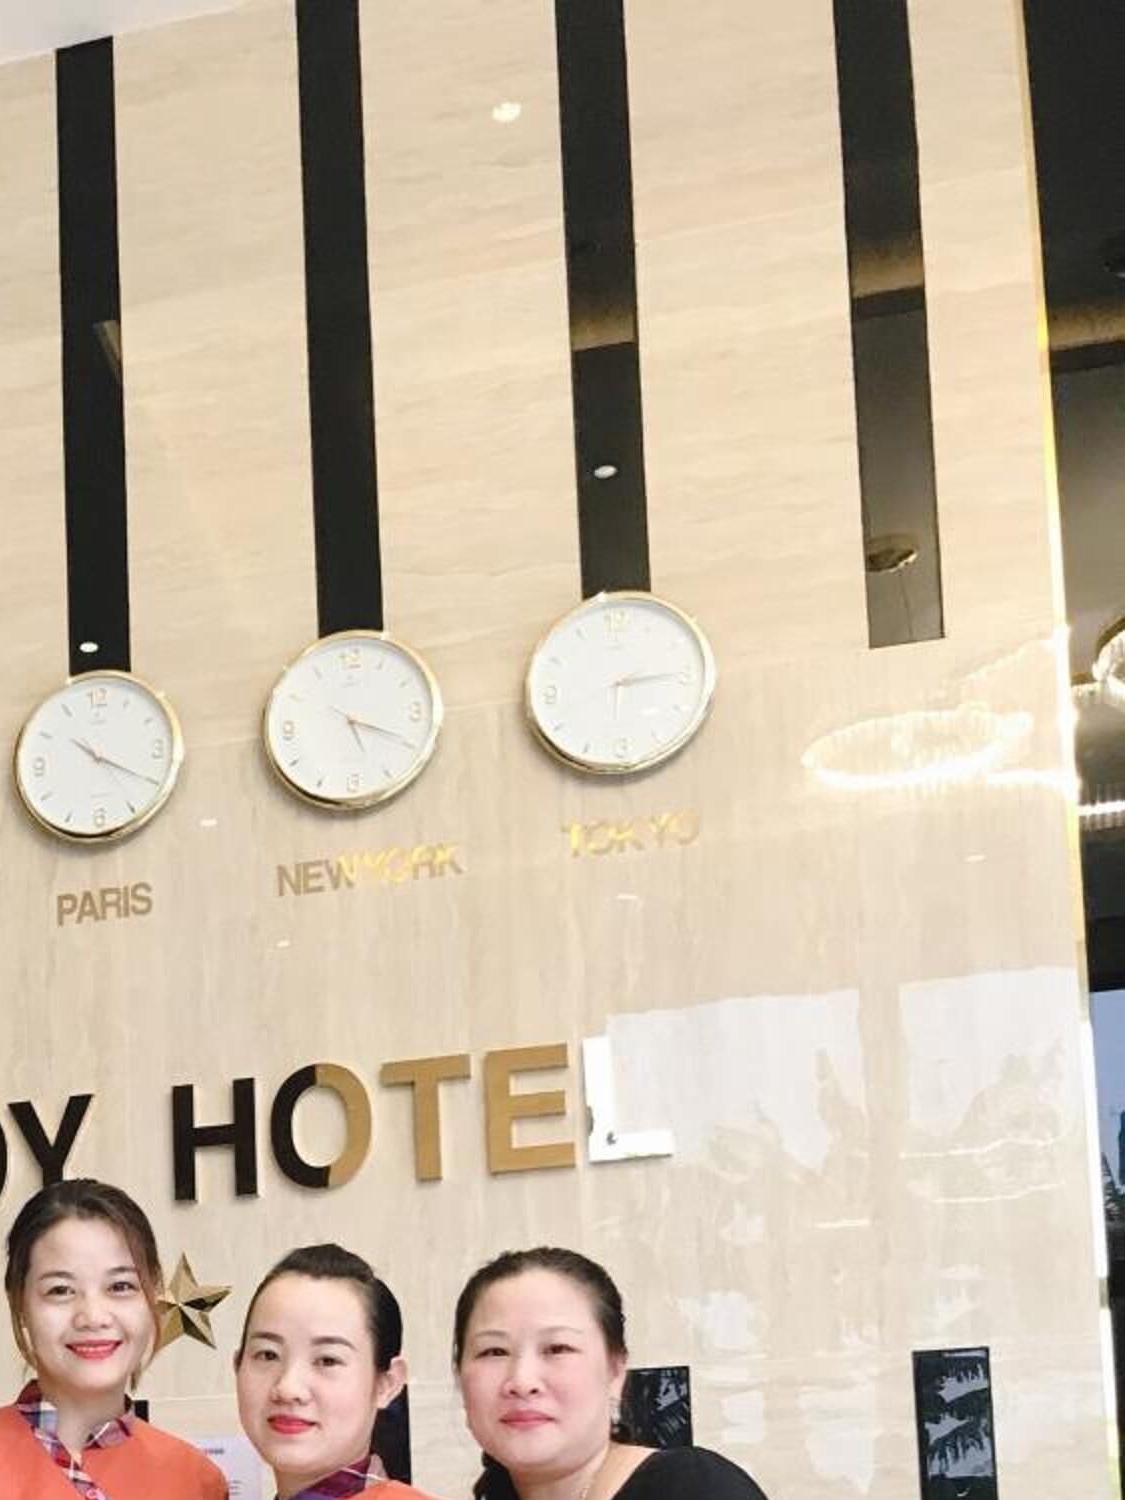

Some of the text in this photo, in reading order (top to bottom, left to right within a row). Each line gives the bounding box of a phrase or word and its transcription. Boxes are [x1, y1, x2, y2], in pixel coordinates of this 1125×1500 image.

[338, 648, 361, 668] 12
[88, 687, 107, 707] 12
[410, 701, 421, 721] 3
[282, 720, 294, 740] 9
[153, 739, 164, 759] 3
[34, 757, 45, 777] 9
[347, 774, 360, 793] 6
[94, 807, 105, 827] 6
[560, 812, 700, 858] TOKYO
[57, 882, 153, 927] PARIS
[171, 1035, 673, 1203] HOTEL
